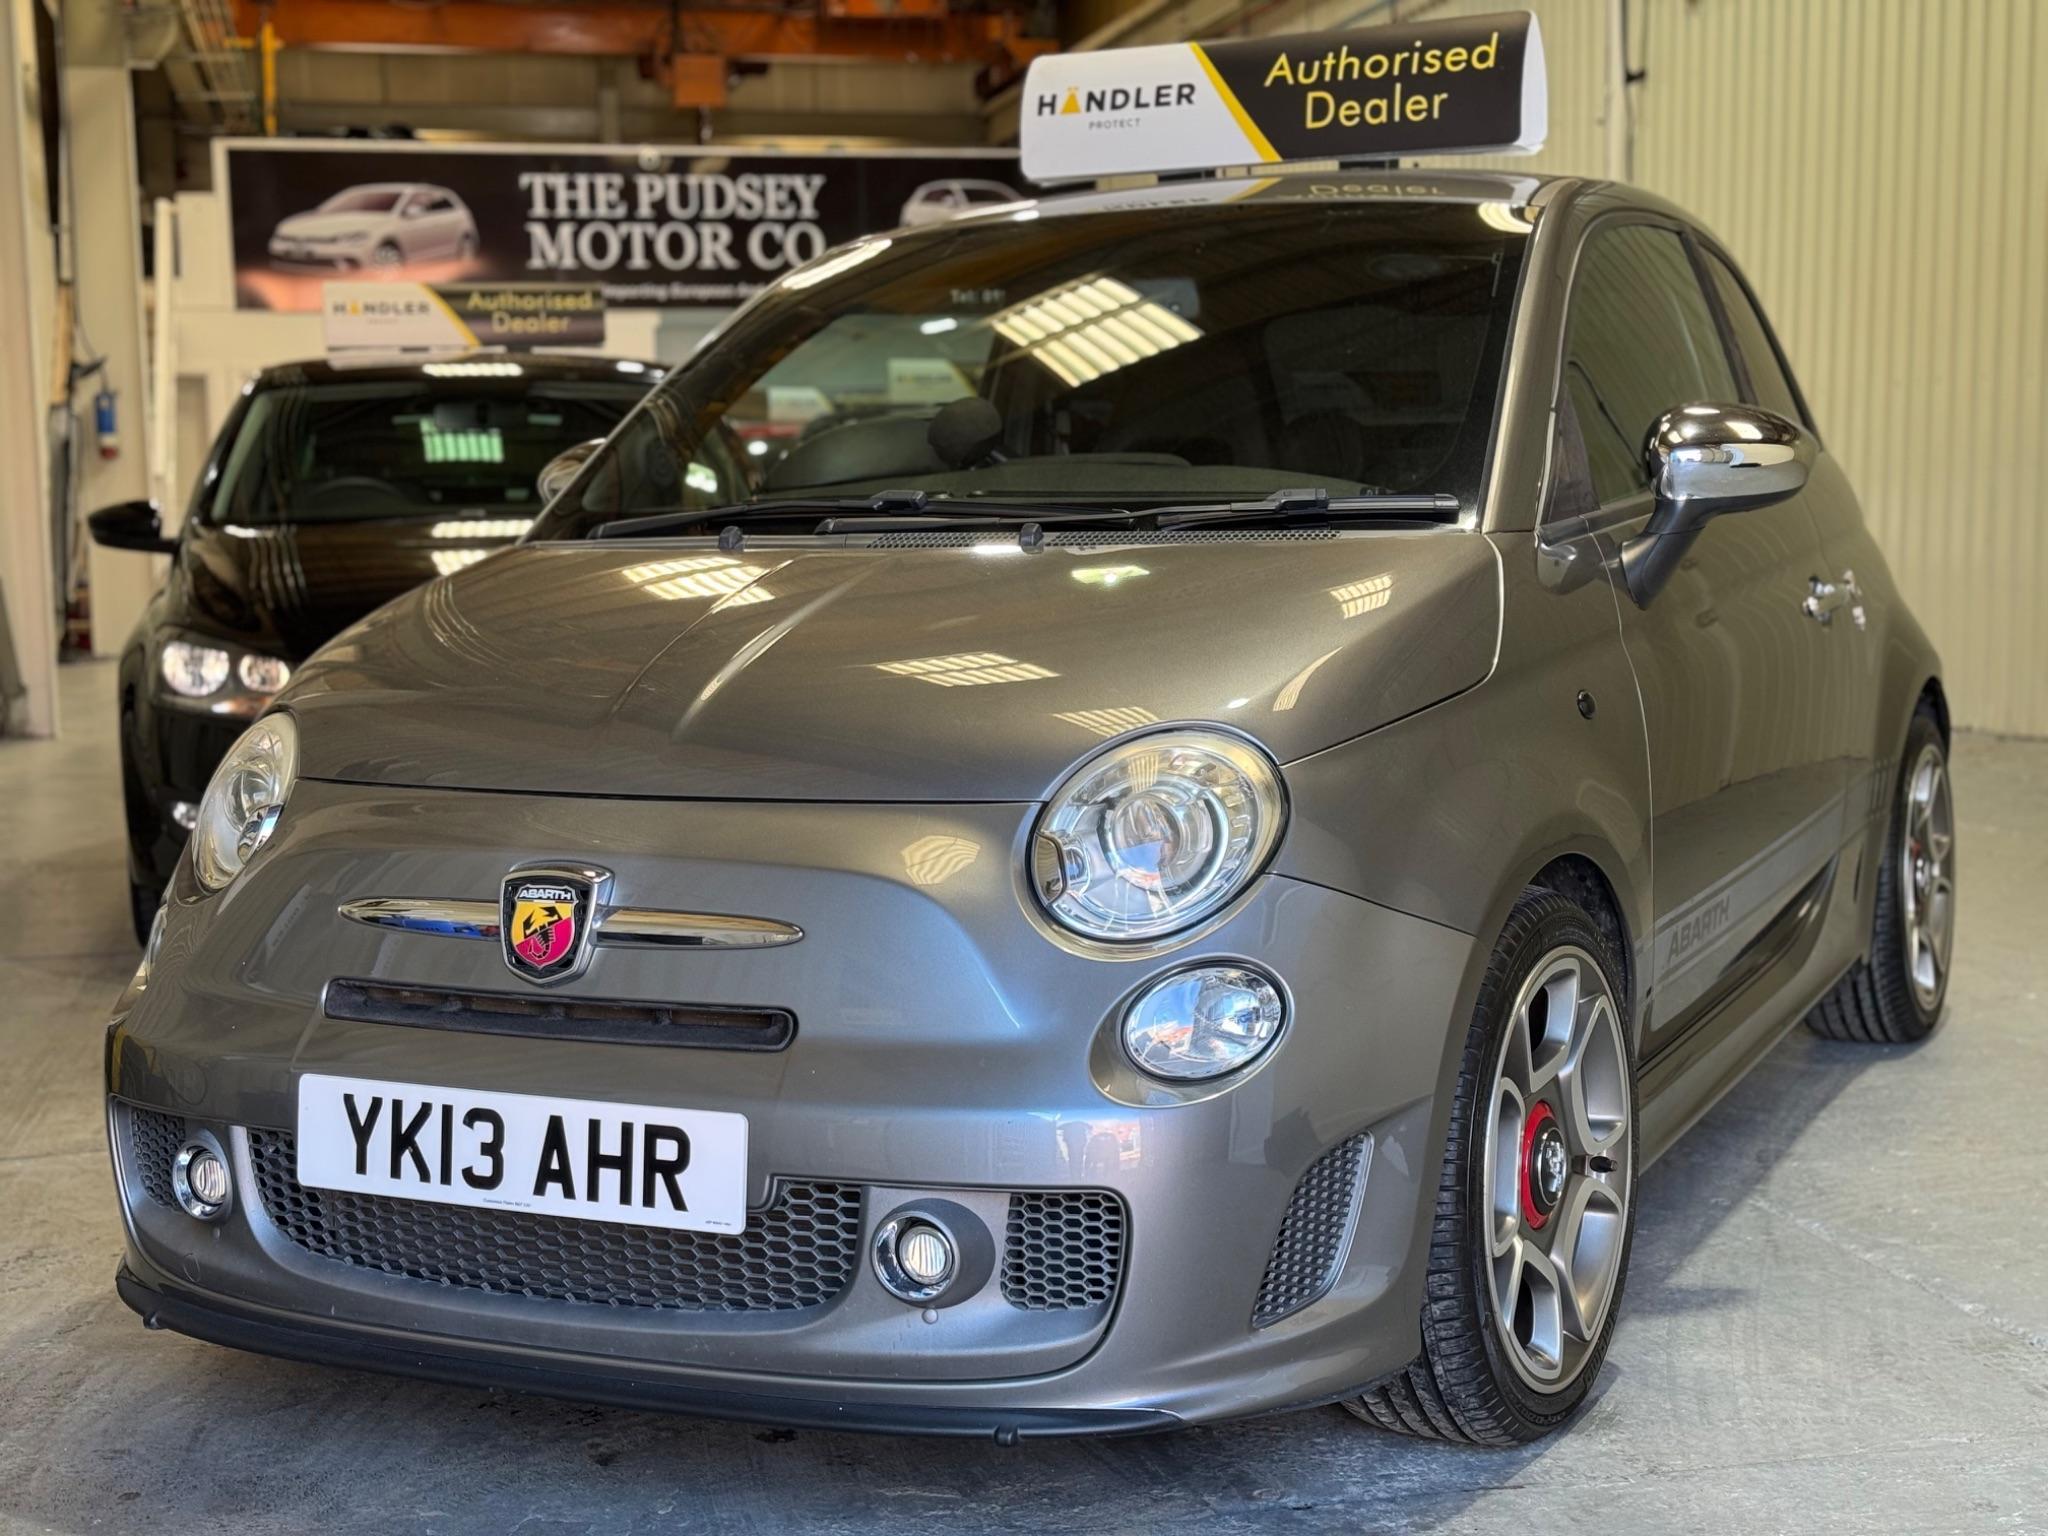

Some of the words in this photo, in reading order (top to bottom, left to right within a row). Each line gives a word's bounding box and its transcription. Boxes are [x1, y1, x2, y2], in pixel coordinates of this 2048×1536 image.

[1263, 31, 1499, 88] Authorised
[1088, 118, 1142, 131] PROTECT
[1305, 82, 1449, 129] Dealer
[518, 172, 628, 220] THE
[631, 172, 827, 220] PUDSEY
[524, 221, 741, 270] MOTOR
[466, 290, 594, 312] Authorised
[491, 310, 571, 334] Dealer
[519, 888, 573, 900] ABARTH
[1667, 894, 1730, 964] ABARTH
[343, 1093, 505, 1191] YK13
[532, 1114, 692, 1213] AHR
